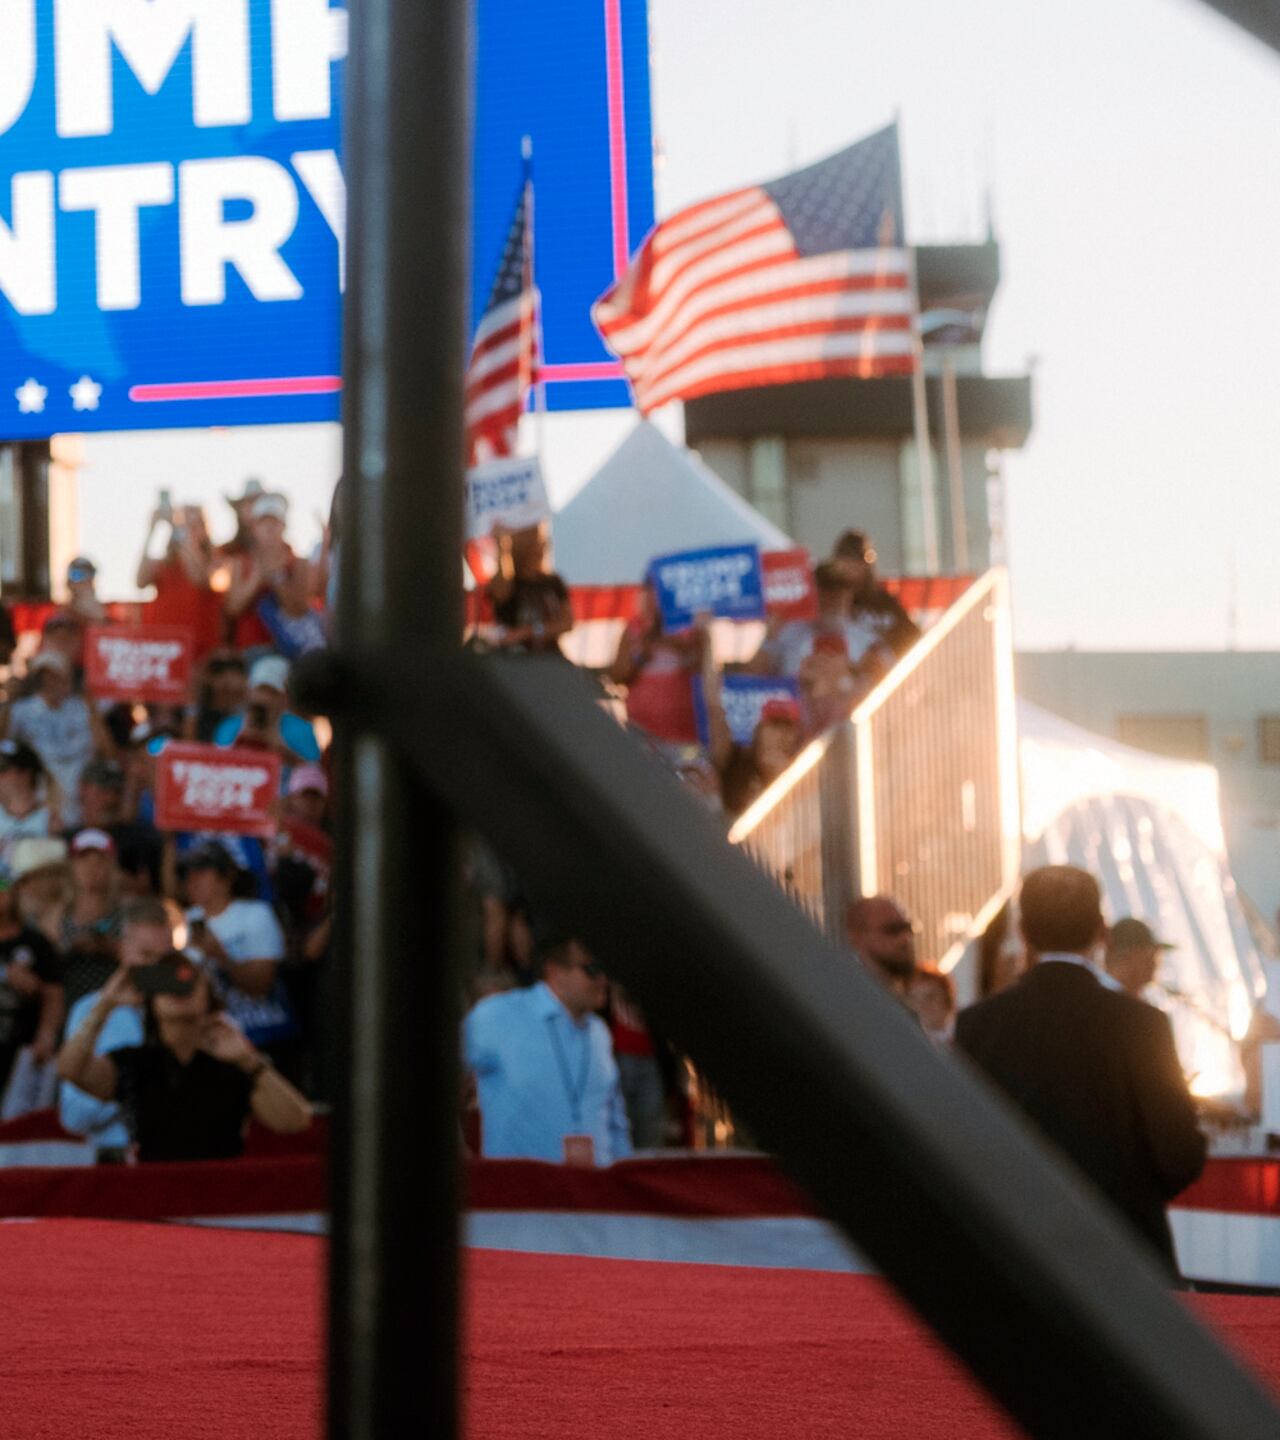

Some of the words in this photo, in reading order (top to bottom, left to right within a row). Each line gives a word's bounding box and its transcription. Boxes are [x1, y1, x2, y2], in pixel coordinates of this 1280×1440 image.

[95, 637, 182, 662] TRUMP
[171, 761, 268, 789] TRUMP
[183, 782, 253, 807] 2024
